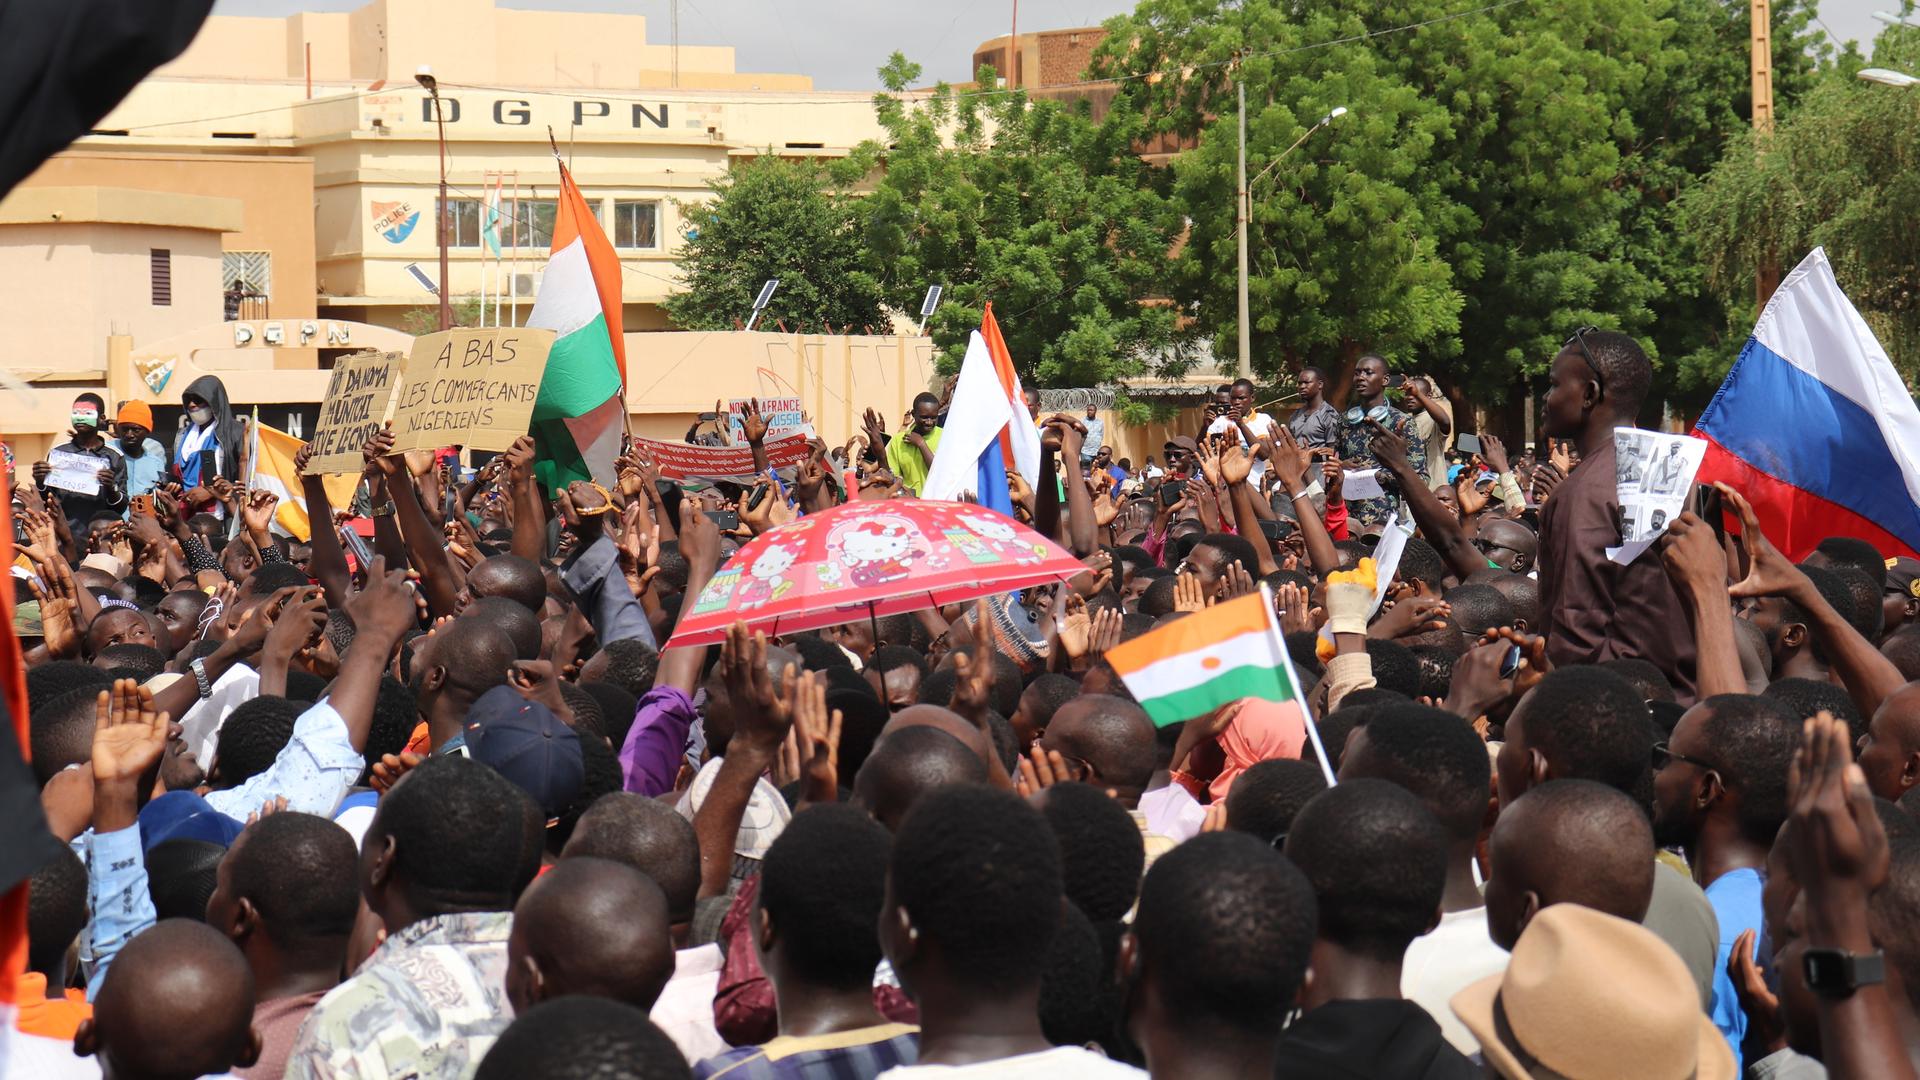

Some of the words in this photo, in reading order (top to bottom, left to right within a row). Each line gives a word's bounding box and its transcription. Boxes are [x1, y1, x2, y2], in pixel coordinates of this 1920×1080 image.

[373, 201, 411, 233] POLICE
[433, 341, 453, 369] A
[462, 338, 519, 368] BAS
[399, 381, 430, 410] LES
[407, 407, 494, 433] NIGERIENS
